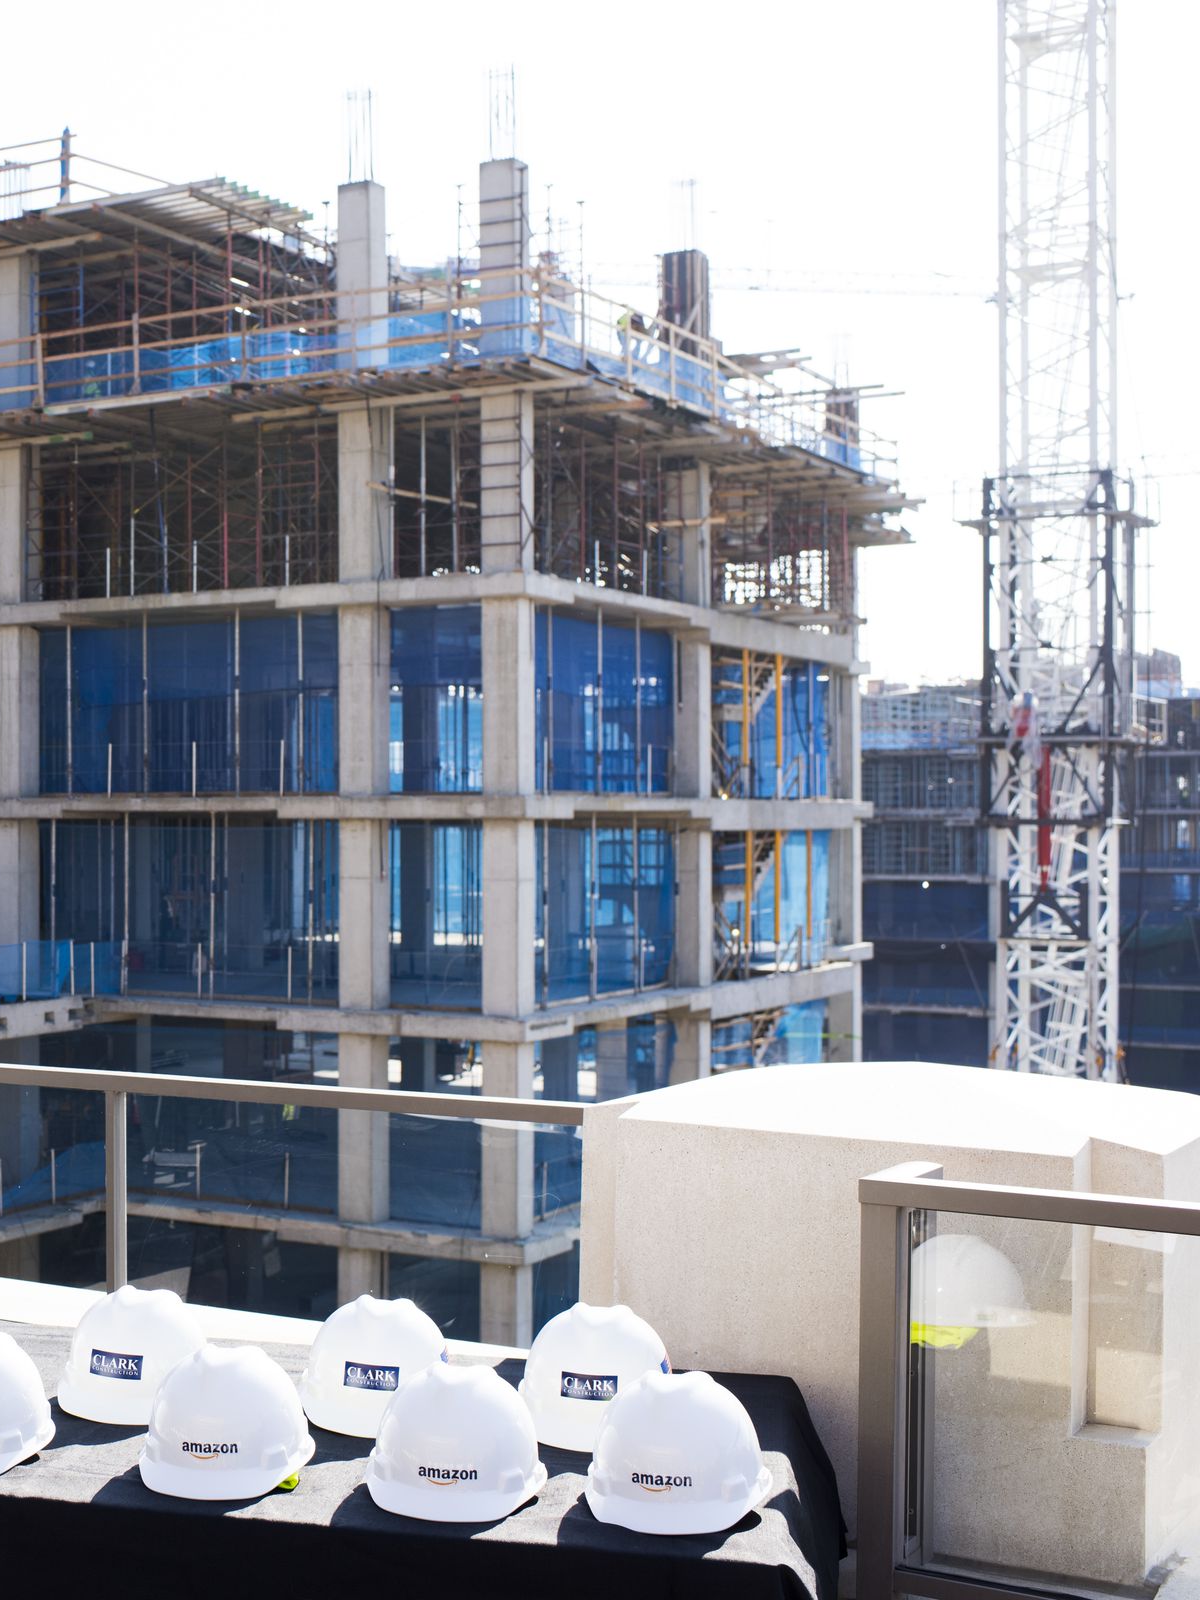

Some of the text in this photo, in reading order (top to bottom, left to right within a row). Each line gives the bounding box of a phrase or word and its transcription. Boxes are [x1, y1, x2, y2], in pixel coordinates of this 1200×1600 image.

[93, 1354, 138, 1371] CLARK
[347, 1366, 396, 1382] CLARK
[564, 1376, 613, 1391] CLARK
[181, 1441, 238, 1454] amazon
[418, 1466, 478, 1480] amazon
[631, 1472, 692, 1487] amazon
